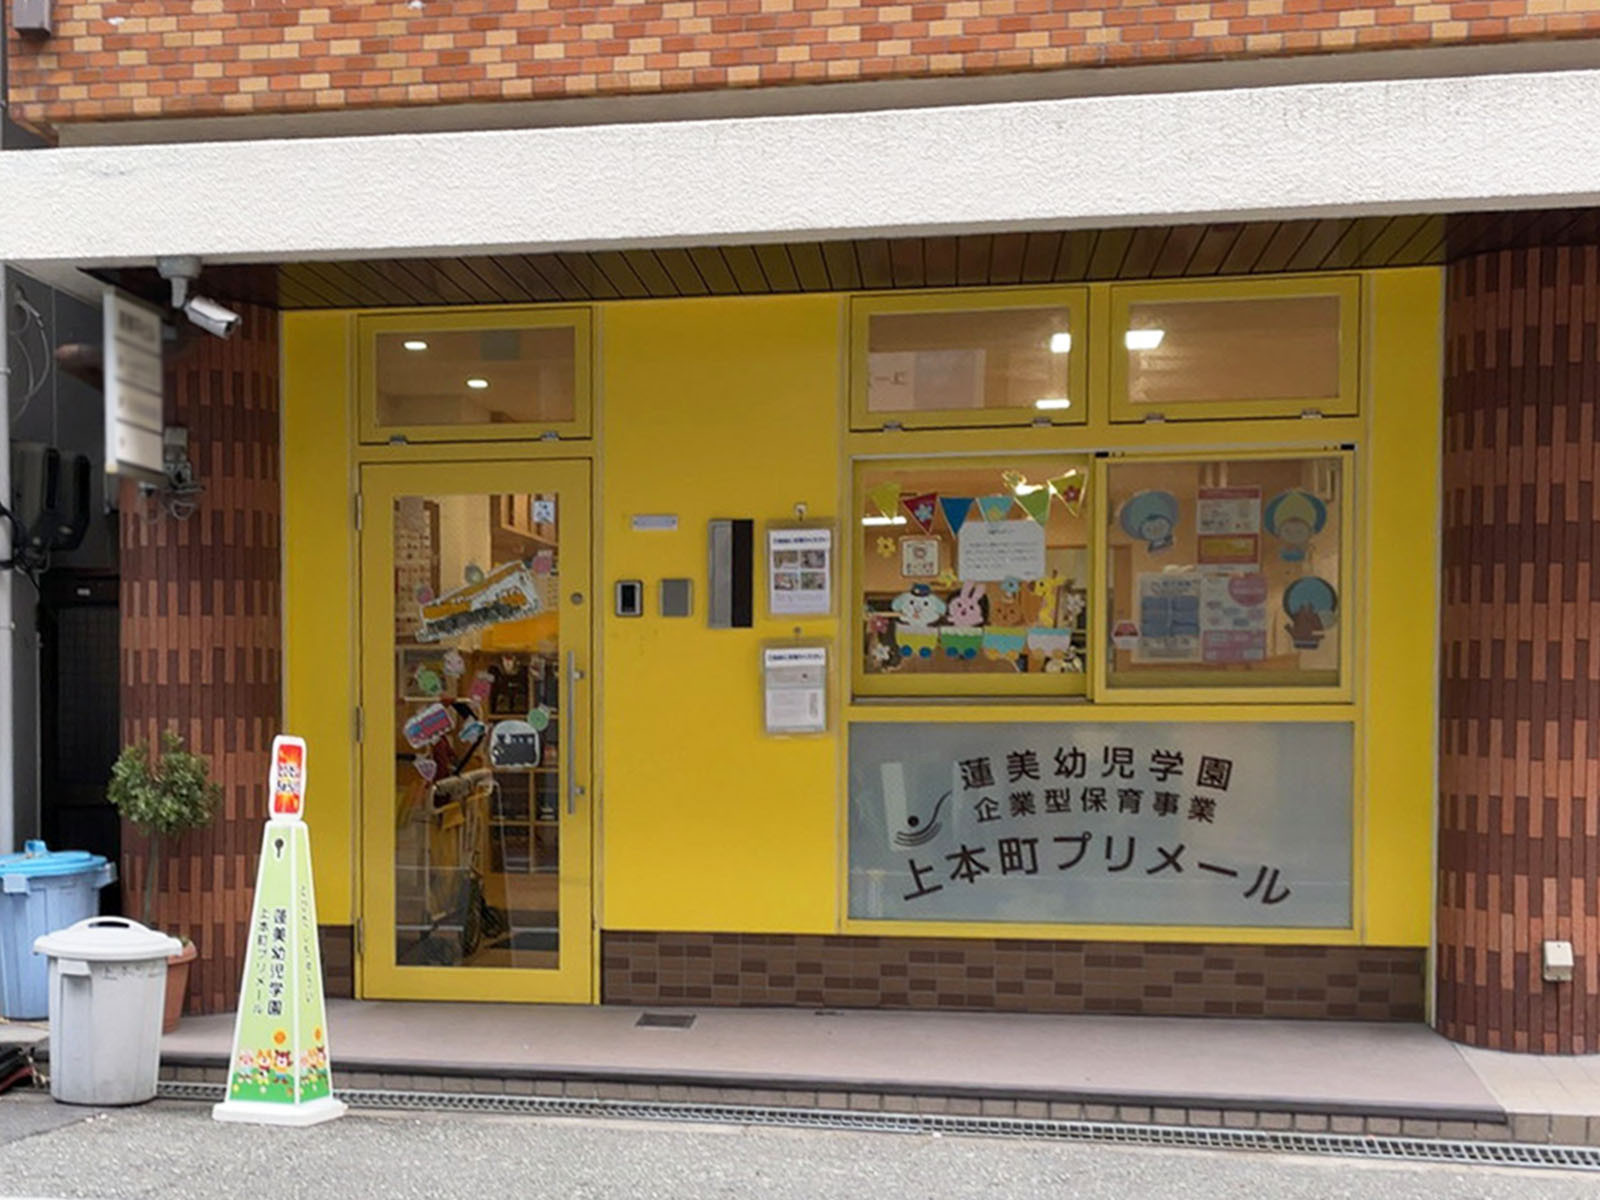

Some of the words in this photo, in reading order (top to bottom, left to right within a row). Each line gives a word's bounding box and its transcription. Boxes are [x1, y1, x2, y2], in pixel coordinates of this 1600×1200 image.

[959, 746, 1233, 793] 蓮美幼児学園
[973, 787, 1217, 824] 企業型保育事業
[902, 830, 1291, 906] 上本町プリメール
